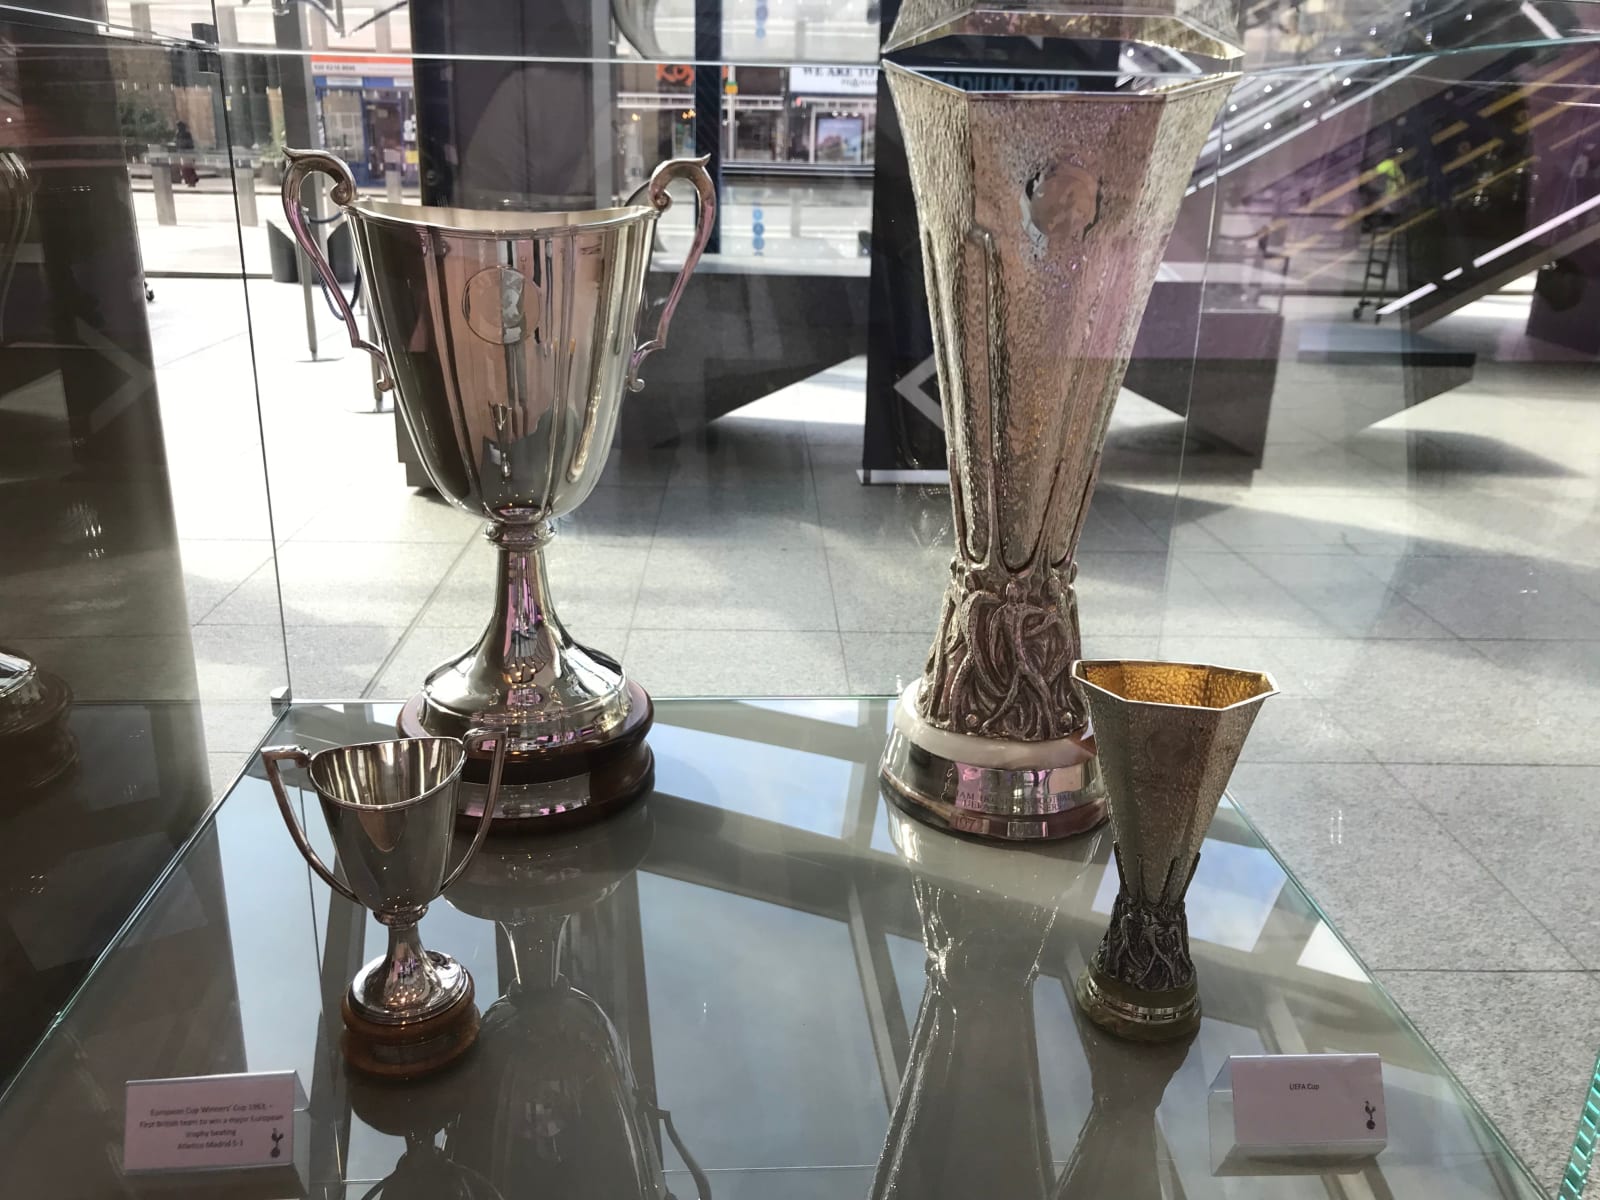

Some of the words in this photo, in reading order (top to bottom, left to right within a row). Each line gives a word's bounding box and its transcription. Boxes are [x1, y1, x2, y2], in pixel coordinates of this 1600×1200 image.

[1020, 76, 1080, 93] TOUR
[1289, 1083, 1306, 1091] UEFA
[1307, 1083, 1320, 1092] Cup
[150, 1108, 184, 1117] European
[186, 1106, 199, 1115] Cup
[233, 1103, 247, 1112] Cup
[139, 1120, 155, 1129] First
[156, 1120, 178, 1128] British
[180, 1118, 198, 1127] team
[209, 1117, 222, 1125] win
[229, 1116, 248, 1125] major
[250, 1114, 284, 1123] European
[185, 1130, 209, 1139] trophy
[210, 1128, 236, 1138] beating
[206, 1140, 231, 1149] Madrid
